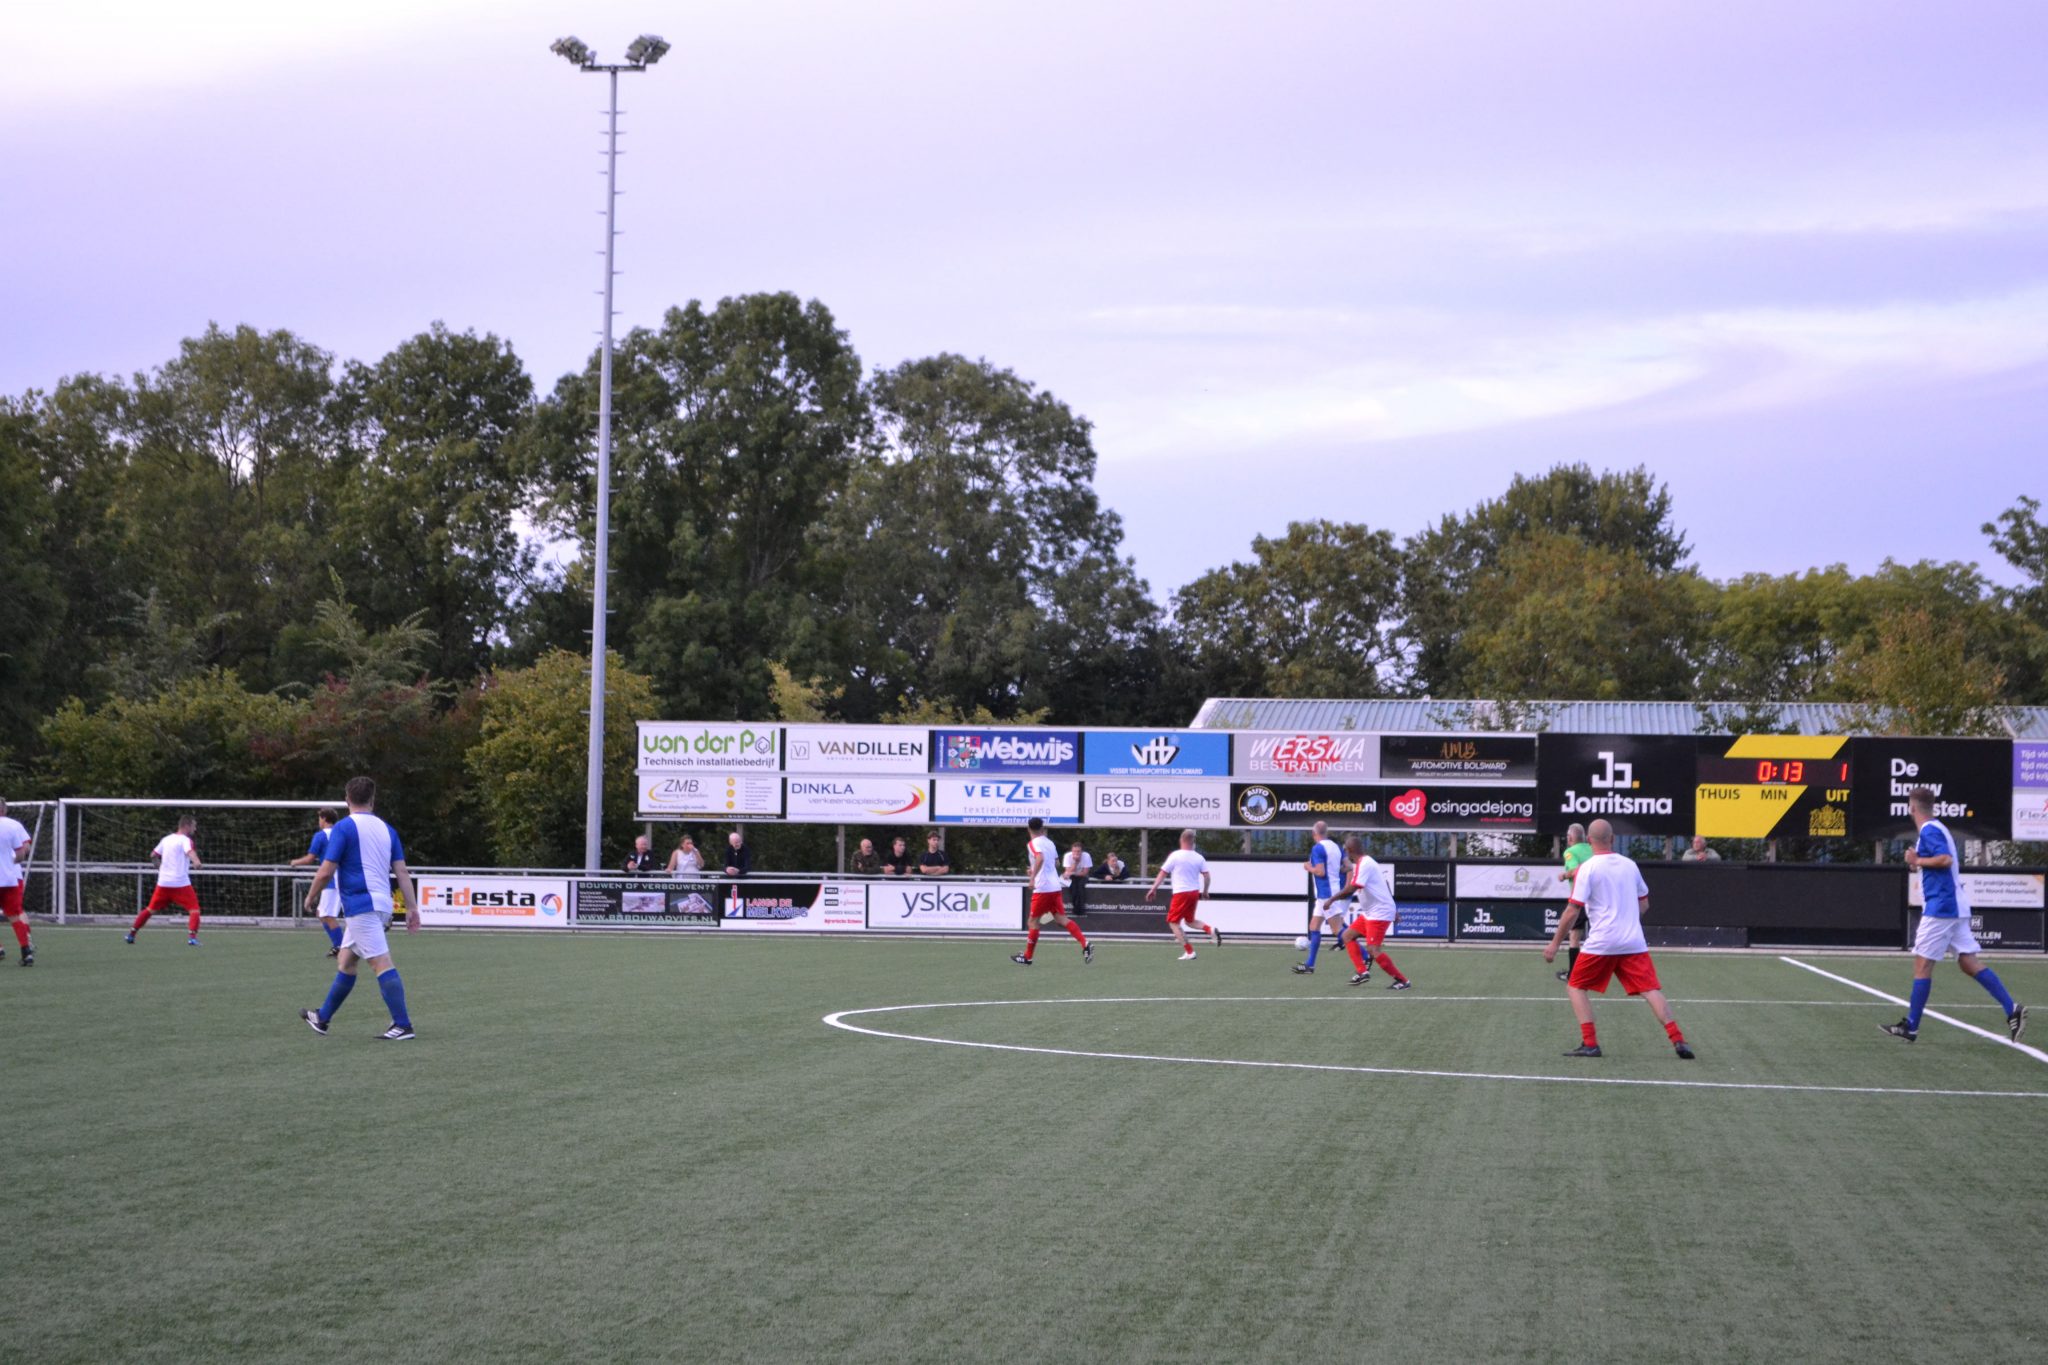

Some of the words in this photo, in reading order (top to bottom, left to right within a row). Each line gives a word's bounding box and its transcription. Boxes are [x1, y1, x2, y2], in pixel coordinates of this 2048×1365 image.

[740, 729, 776, 754] Pol
[818, 741, 923, 756] VANDILLEN
[1250, 737, 1366, 760] WIERSMA
[643, 757, 694, 766] Technisch
[696, 757, 775, 768] installatiebedrijf
[1250, 759, 1365, 772] BESTRATINGEN
[1411, 761, 1462, 770] AUTOMOTIVE
[1464, 762, 1507, 770] BOLSWARD
[1890, 758, 1919, 777] De
[1758, 761, 1803, 782] 0:13
[664, 780, 699, 792] ZMB
[791, 783, 855, 795] DINKLA
[964, 780, 1051, 803] VELZEN
[1247, 788, 1269, 797] AUTO
[808, 796, 906, 807] verkeersopleidingen
[1101, 793, 1135, 808] BKB
[1146, 793, 1221, 808] keukens
[1700, 789, 1741, 800] THUIS
[1760, 789, 1788, 800] MIN
[1826, 789, 1850, 802] UIT
[1279, 799, 1377, 813] AutoFoekema.nl
[1395, 797, 1421, 817] odj
[1431, 799, 1533, 817] osingadejong
[1561, 791, 1672, 815] Jorritsma
[963, 806, 1051, 816] textielreiniging
[1146, 811, 1221, 821] bkbbolsward.nl
[1241, 806, 1275, 822] FOEKEMA
[642, 883, 716, 891] VERBOUWEN??
[422, 887, 535, 907] F-idesta
[1119, 903, 1166, 911] Verduurzamen
[1545, 909, 1557, 917] De
[1463, 924, 1505, 933] Jorritsma
